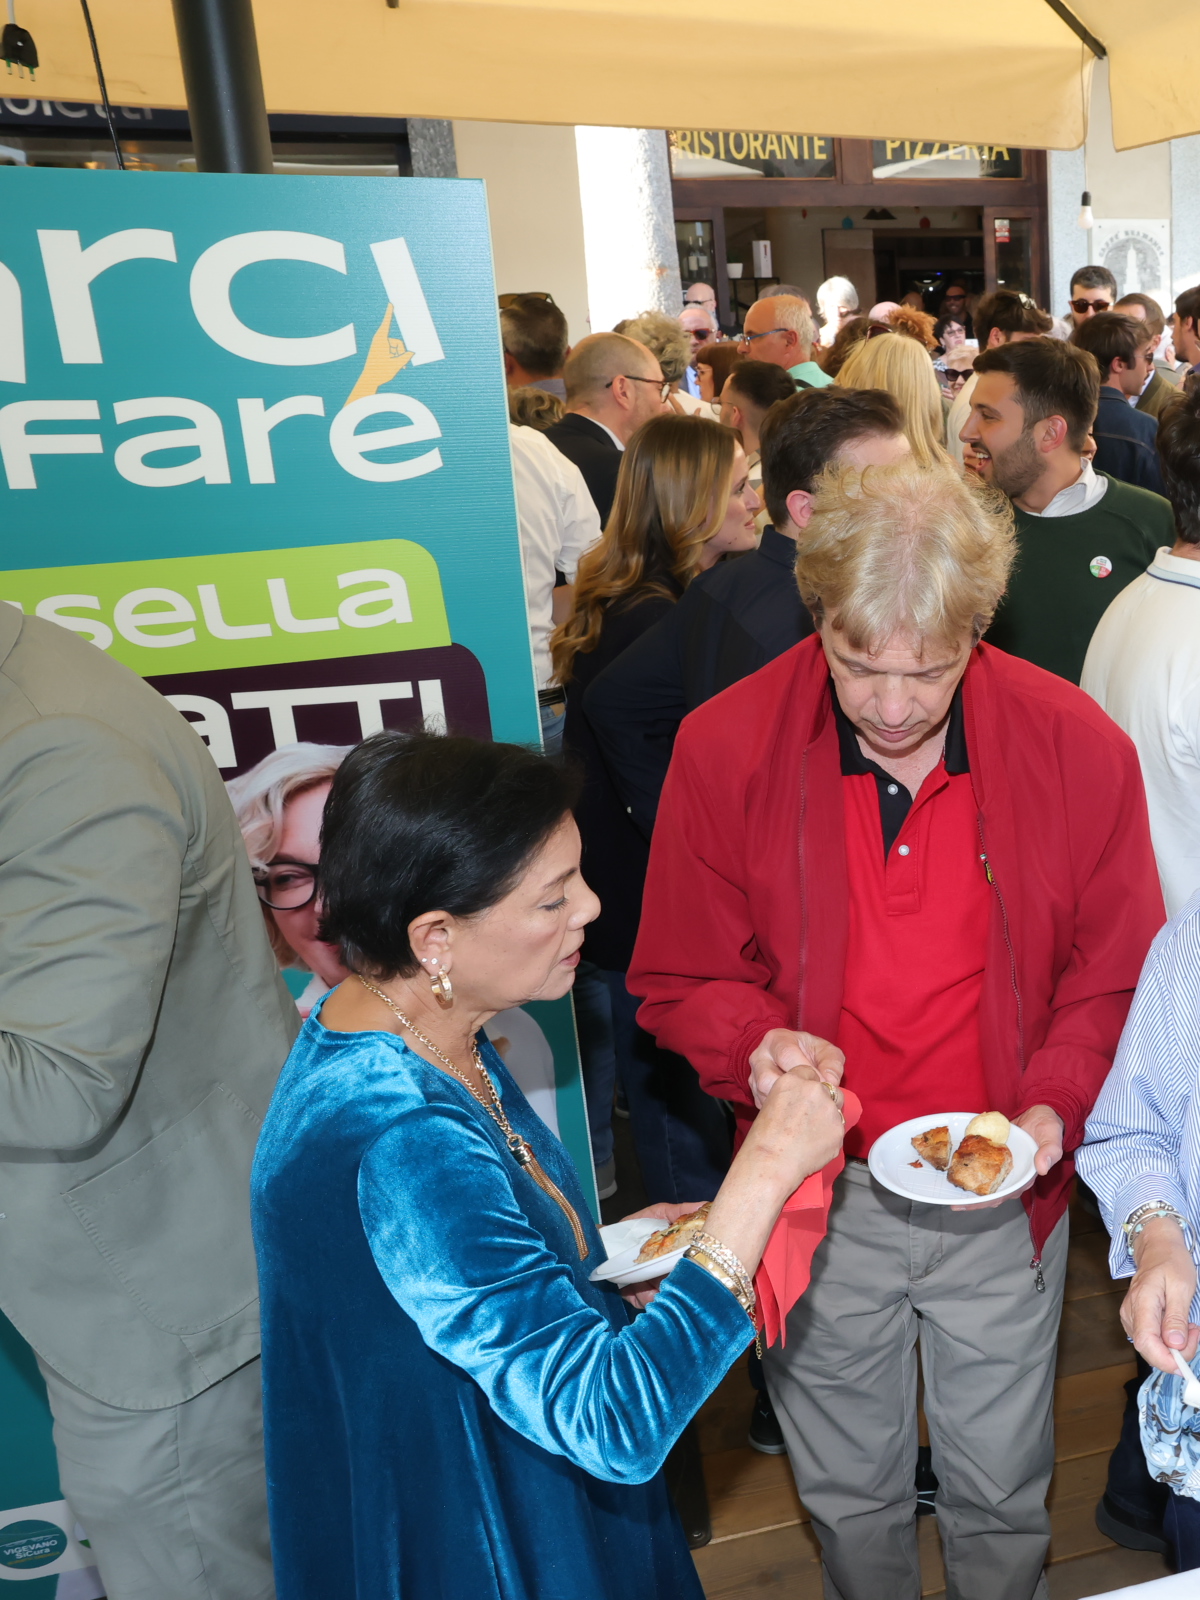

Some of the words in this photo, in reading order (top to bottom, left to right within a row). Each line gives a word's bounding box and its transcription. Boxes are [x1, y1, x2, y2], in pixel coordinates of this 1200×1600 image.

[677, 130, 828, 160] RISTORANTE
[885, 140, 1010, 160] PIZZERIA
[3, 1539, 58, 1556] VIGEVANO
[15, 1548, 51, 1559] SiCura
